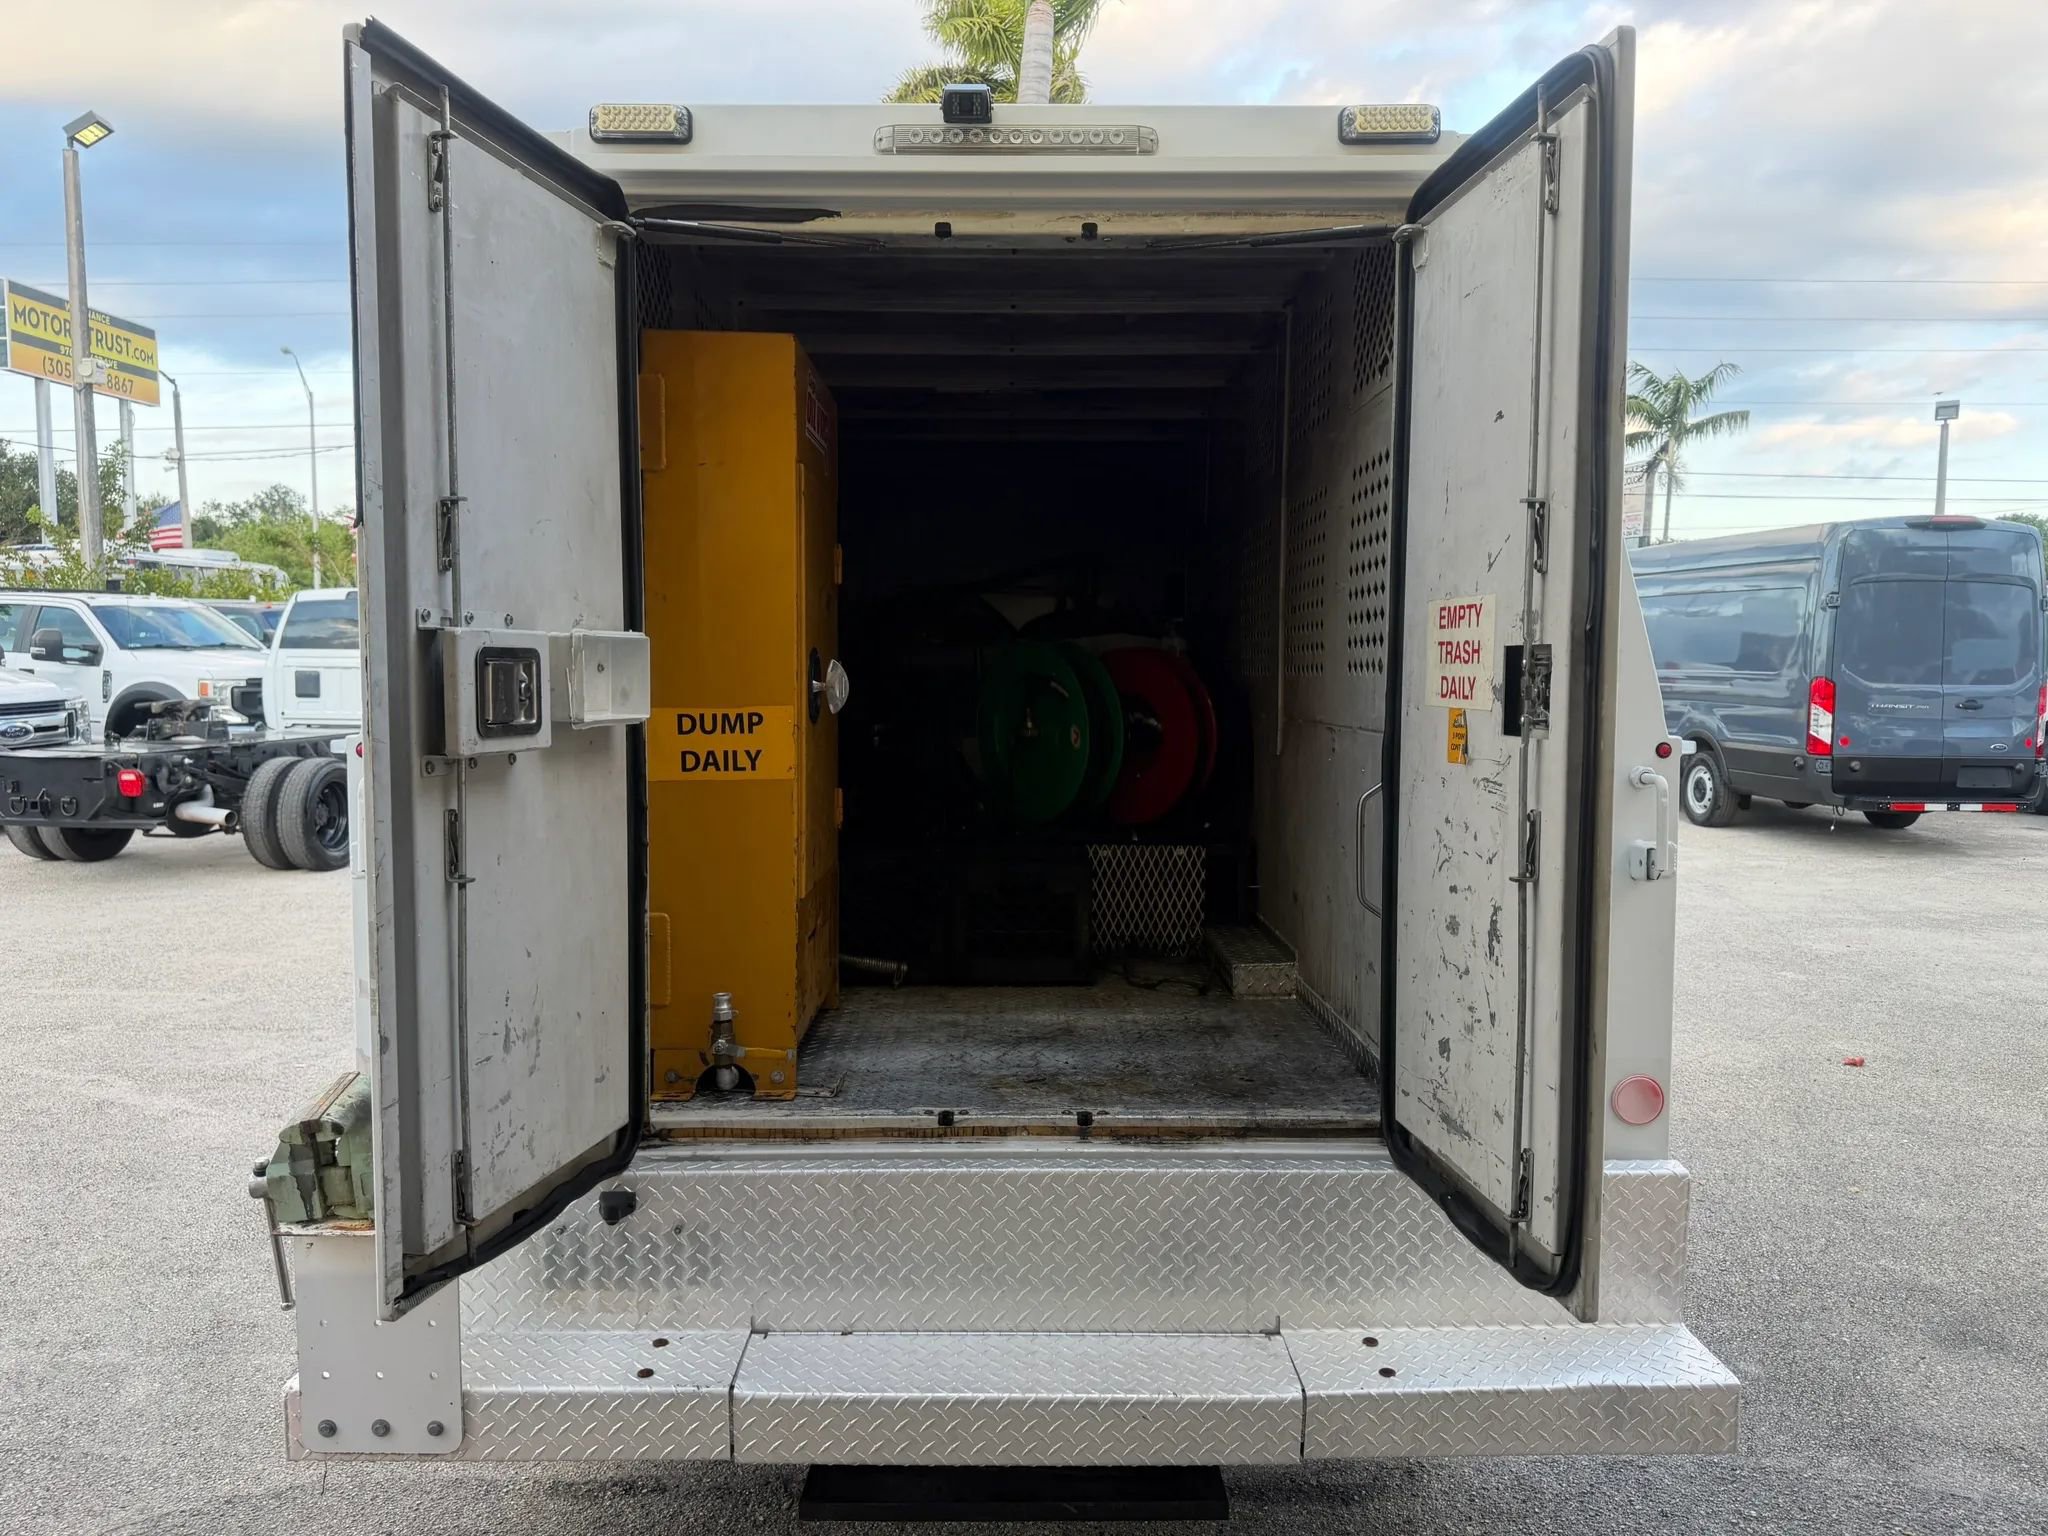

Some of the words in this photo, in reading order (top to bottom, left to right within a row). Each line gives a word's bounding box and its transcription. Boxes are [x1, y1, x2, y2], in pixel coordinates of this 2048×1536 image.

[1438, 603, 1483, 630] EMPTY
[1438, 640, 1482, 664] TRASH
[1440, 675, 1477, 700] DAILY
[676, 712, 764, 735] DUMP
[680, 749, 762, 772] DAILY
